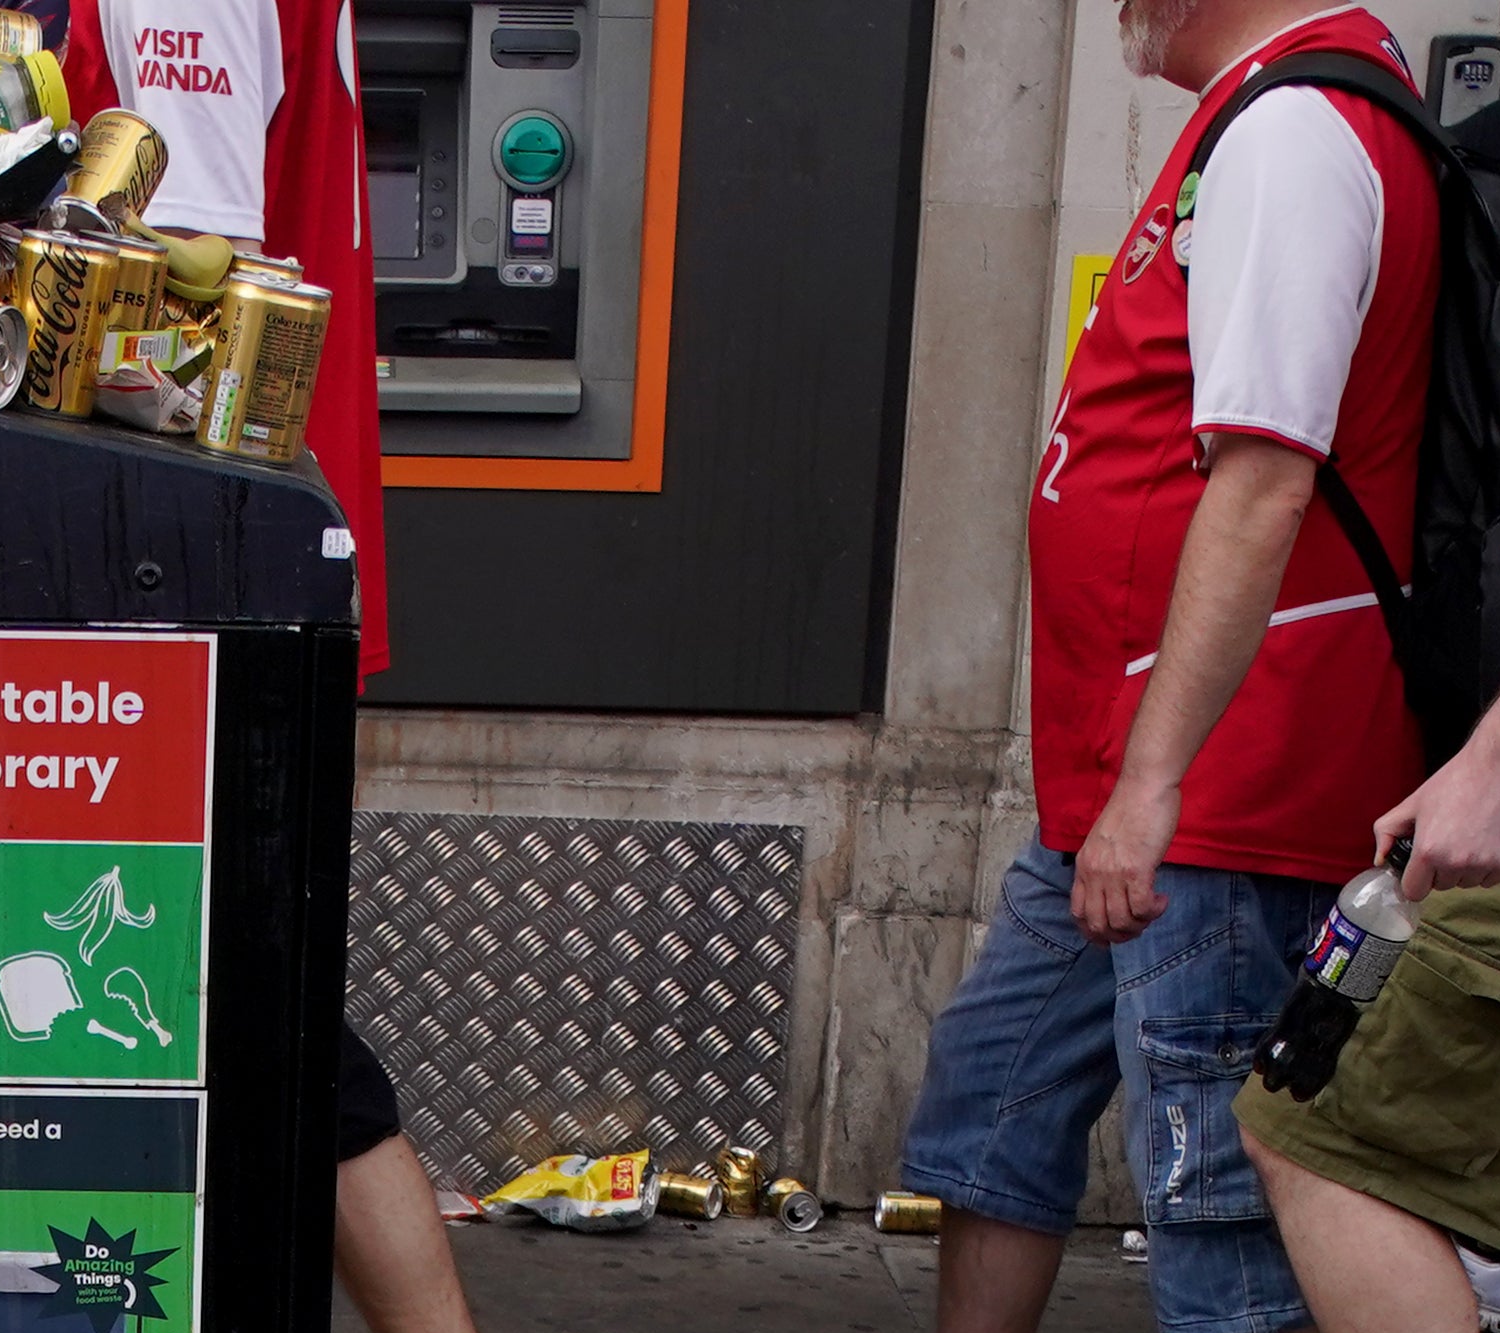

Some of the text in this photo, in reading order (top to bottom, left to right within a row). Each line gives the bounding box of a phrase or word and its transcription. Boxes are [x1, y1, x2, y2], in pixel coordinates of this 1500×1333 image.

[134, 28, 203, 59] VISIT
[137, 60, 232, 96] WANDA
[44, 1123, 62, 1140] a
[85, 1244, 110, 1259] Do
[64, 1258, 135, 1276] Amazing
[73, 1272, 122, 1288] Things
